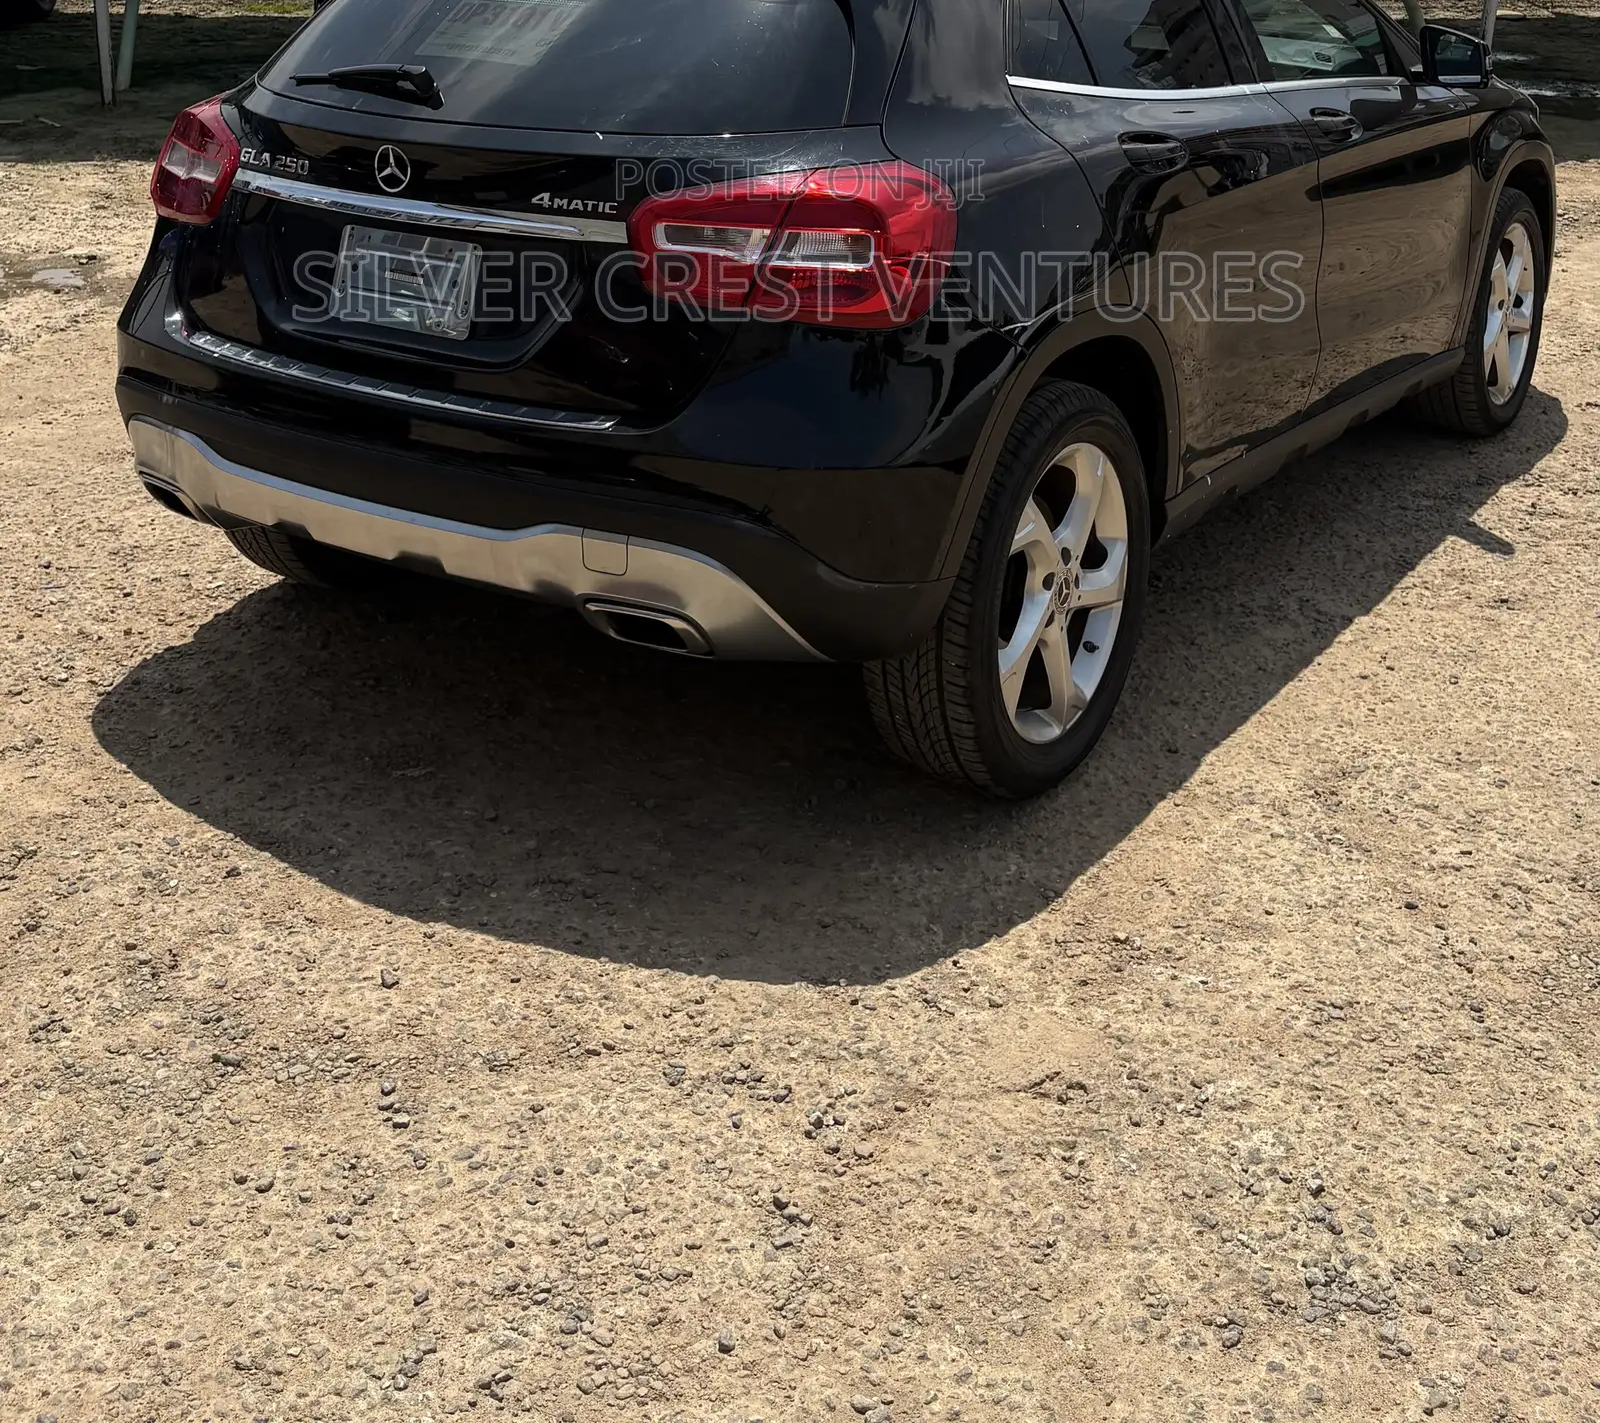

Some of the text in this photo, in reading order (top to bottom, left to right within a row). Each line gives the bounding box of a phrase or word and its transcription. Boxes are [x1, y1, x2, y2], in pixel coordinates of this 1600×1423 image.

[240, 147, 309, 176] GLA 250
[531, 192, 618, 214] 4MATIC
